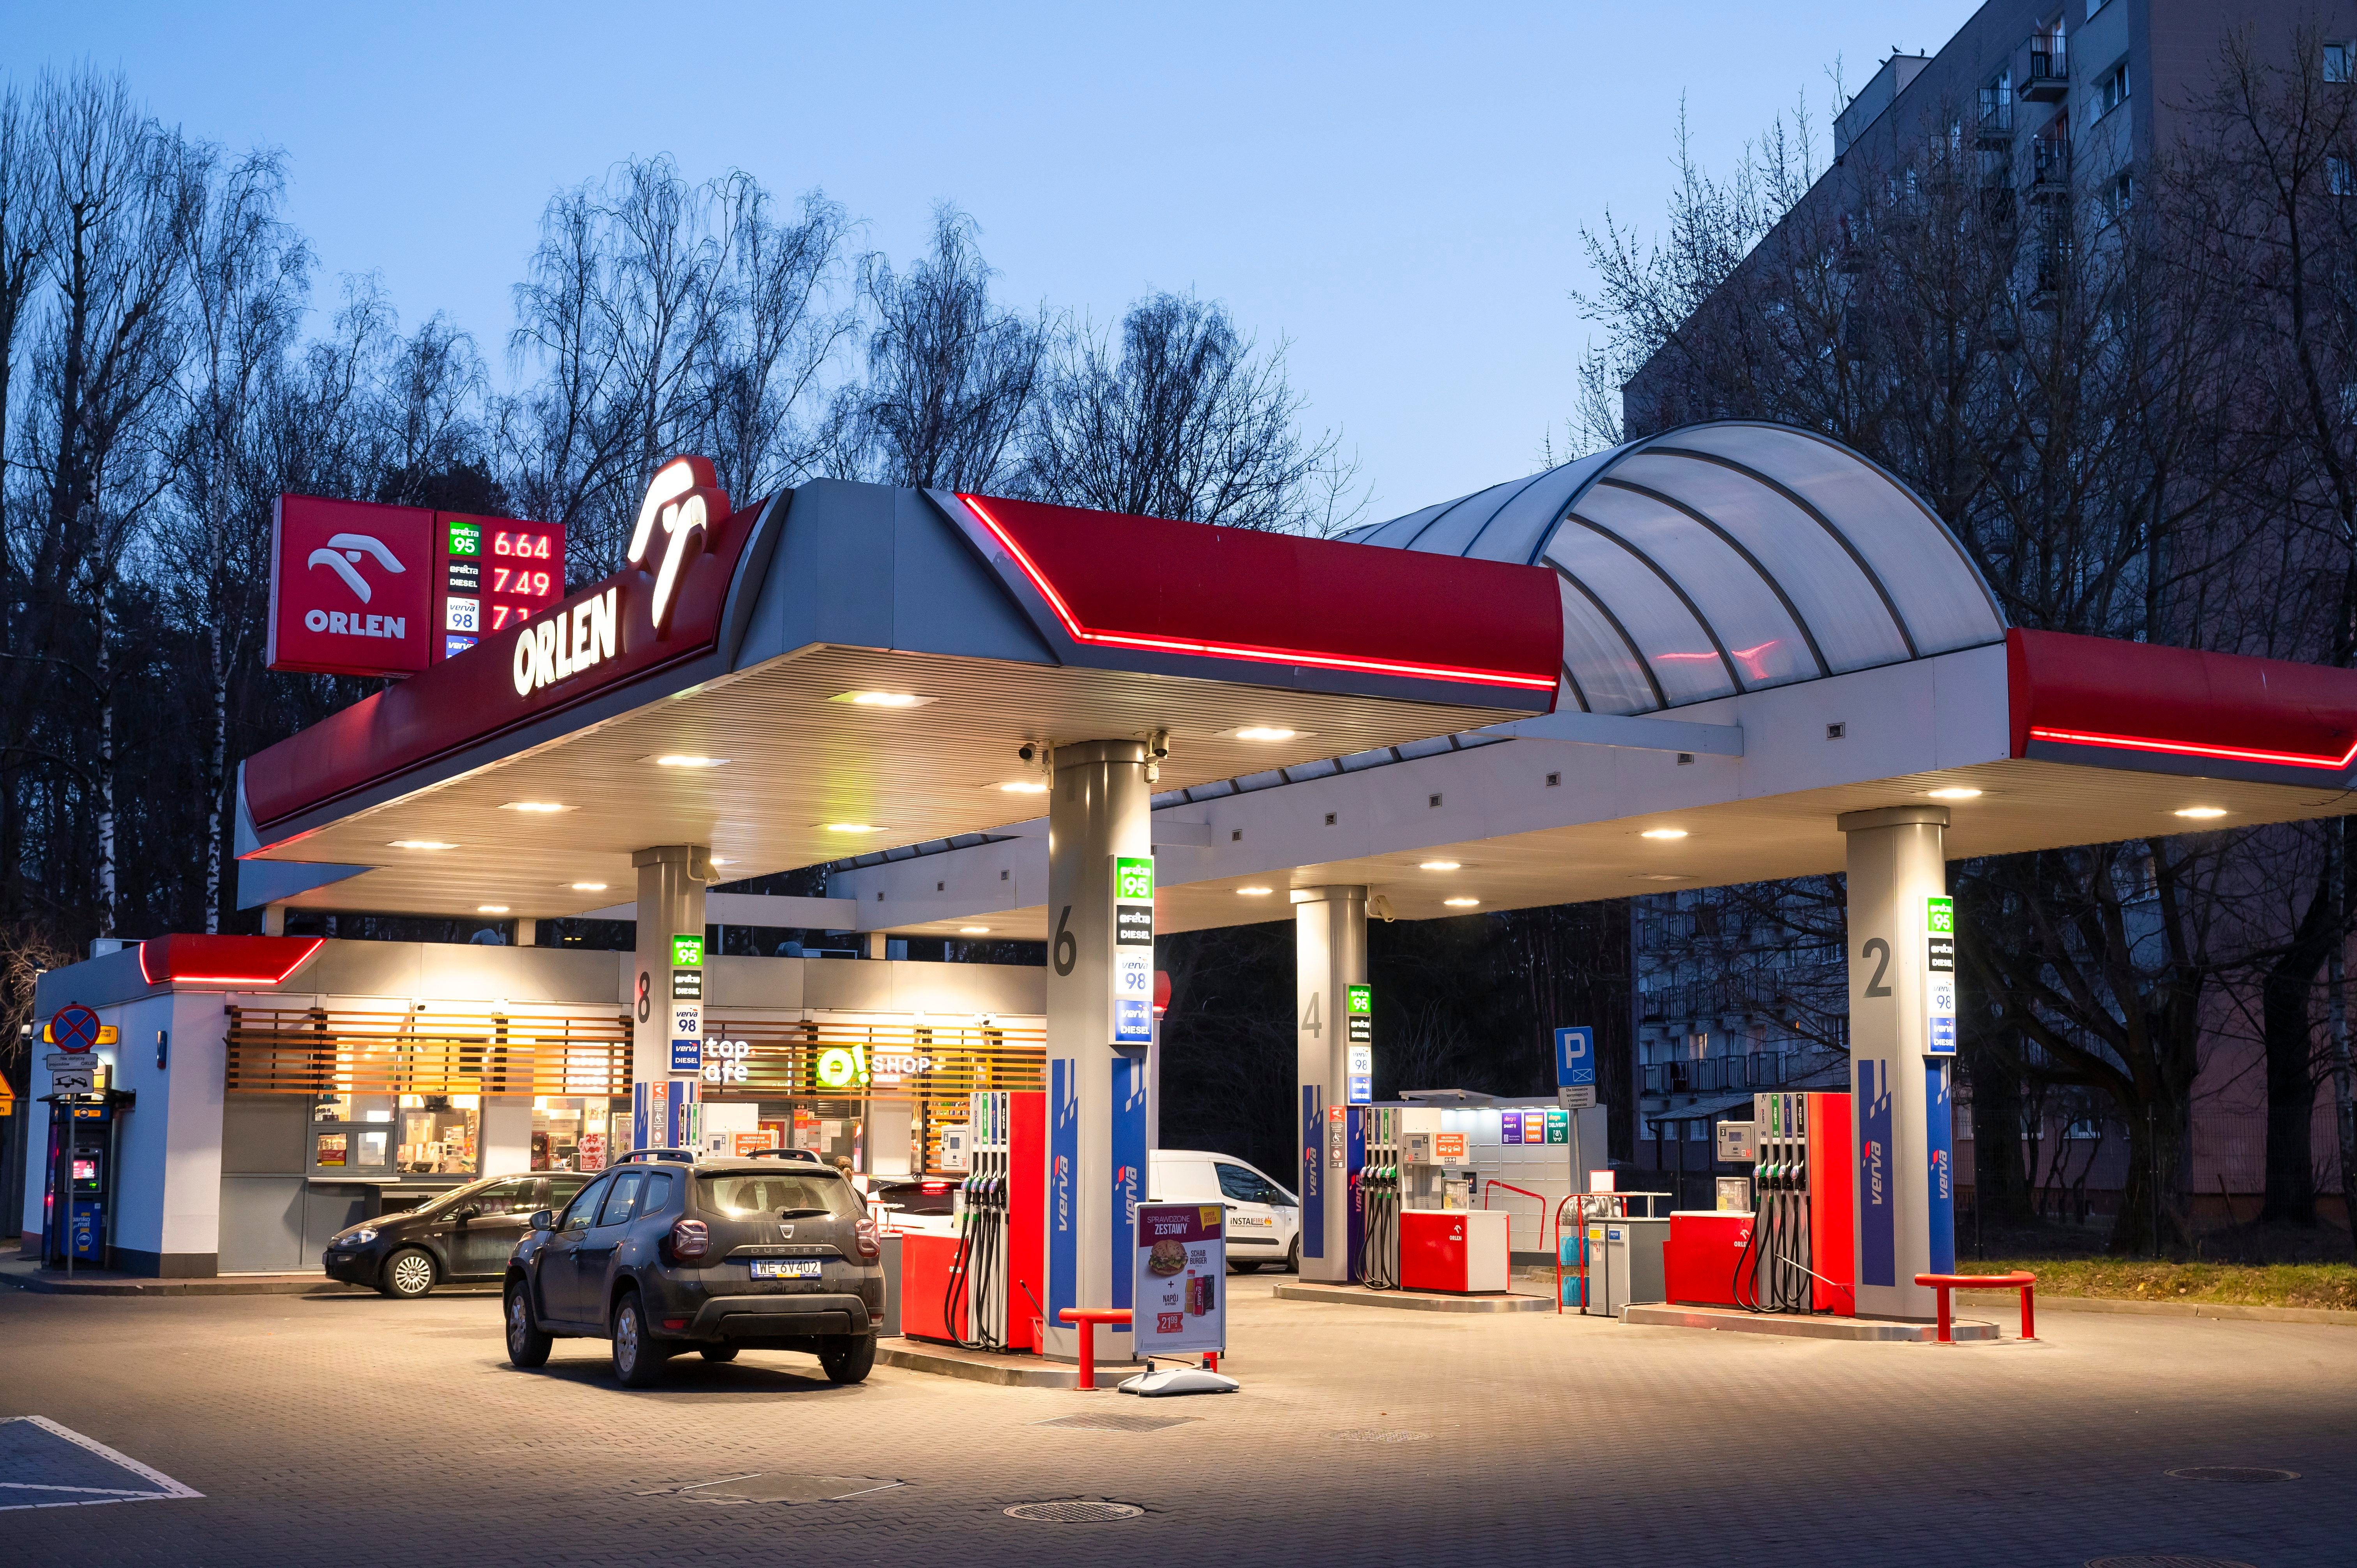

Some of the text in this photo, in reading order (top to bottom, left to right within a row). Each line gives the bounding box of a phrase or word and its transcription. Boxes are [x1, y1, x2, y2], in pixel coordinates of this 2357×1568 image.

[451, 528, 479, 537] efecta
[454, 537, 475, 553] 95
[494, 531, 550, 560] 6.64
[449, 565, 479, 575] efecta
[449, 578, 478, 588] DIESEL
[493, 568, 550, 596] 7.49
[450, 604, 475, 612] verva
[305, 609, 405, 639] ORLEN
[452, 614, 472, 628] 98
[513, 586, 617, 696] ORLEN
[1124, 877, 1148, 895] 95
[1933, 914, 1950, 930] 95
[1053, 905, 1077, 977] 6
[1120, 930, 1150, 940] DIESEL
[678, 949, 698, 963] 95
[1932, 958, 1953, 967] DIESEL
[1122, 961, 1148, 970] verva
[1862, 937, 1892, 998] 2
[1125, 973, 1146, 990] 98
[638, 971, 650, 1024] 8
[1353, 998, 1368, 1010] 95
[1936, 995, 1951, 1009] 98
[1121, 1009, 1149, 1019] verva
[1301, 992, 1322, 1038] 4
[678, 1019, 696, 1032] 98
[1120, 1026, 1150, 1035] DIESEL
[702, 1037, 749, 1063] top
[1933, 1038, 1954, 1046] DIESEL
[1564, 1033, 1585, 1069] P
[701, 1059, 749, 1083] afe
[871, 1056, 930, 1074] SHOP
[1355, 1059, 1368, 1070] 98
[1871, 1141, 1882, 1205] verva
[1939, 1150, 1948, 1199] verva
[1059, 1155, 1068, 1231] verva
[1126, 1166, 1137, 1225] verva
[1155, 1223, 1187, 1235] ZESTAWY
[760, 1261, 776, 1273] WE
[1163, 1293, 1178, 1303] NAPÓJ
